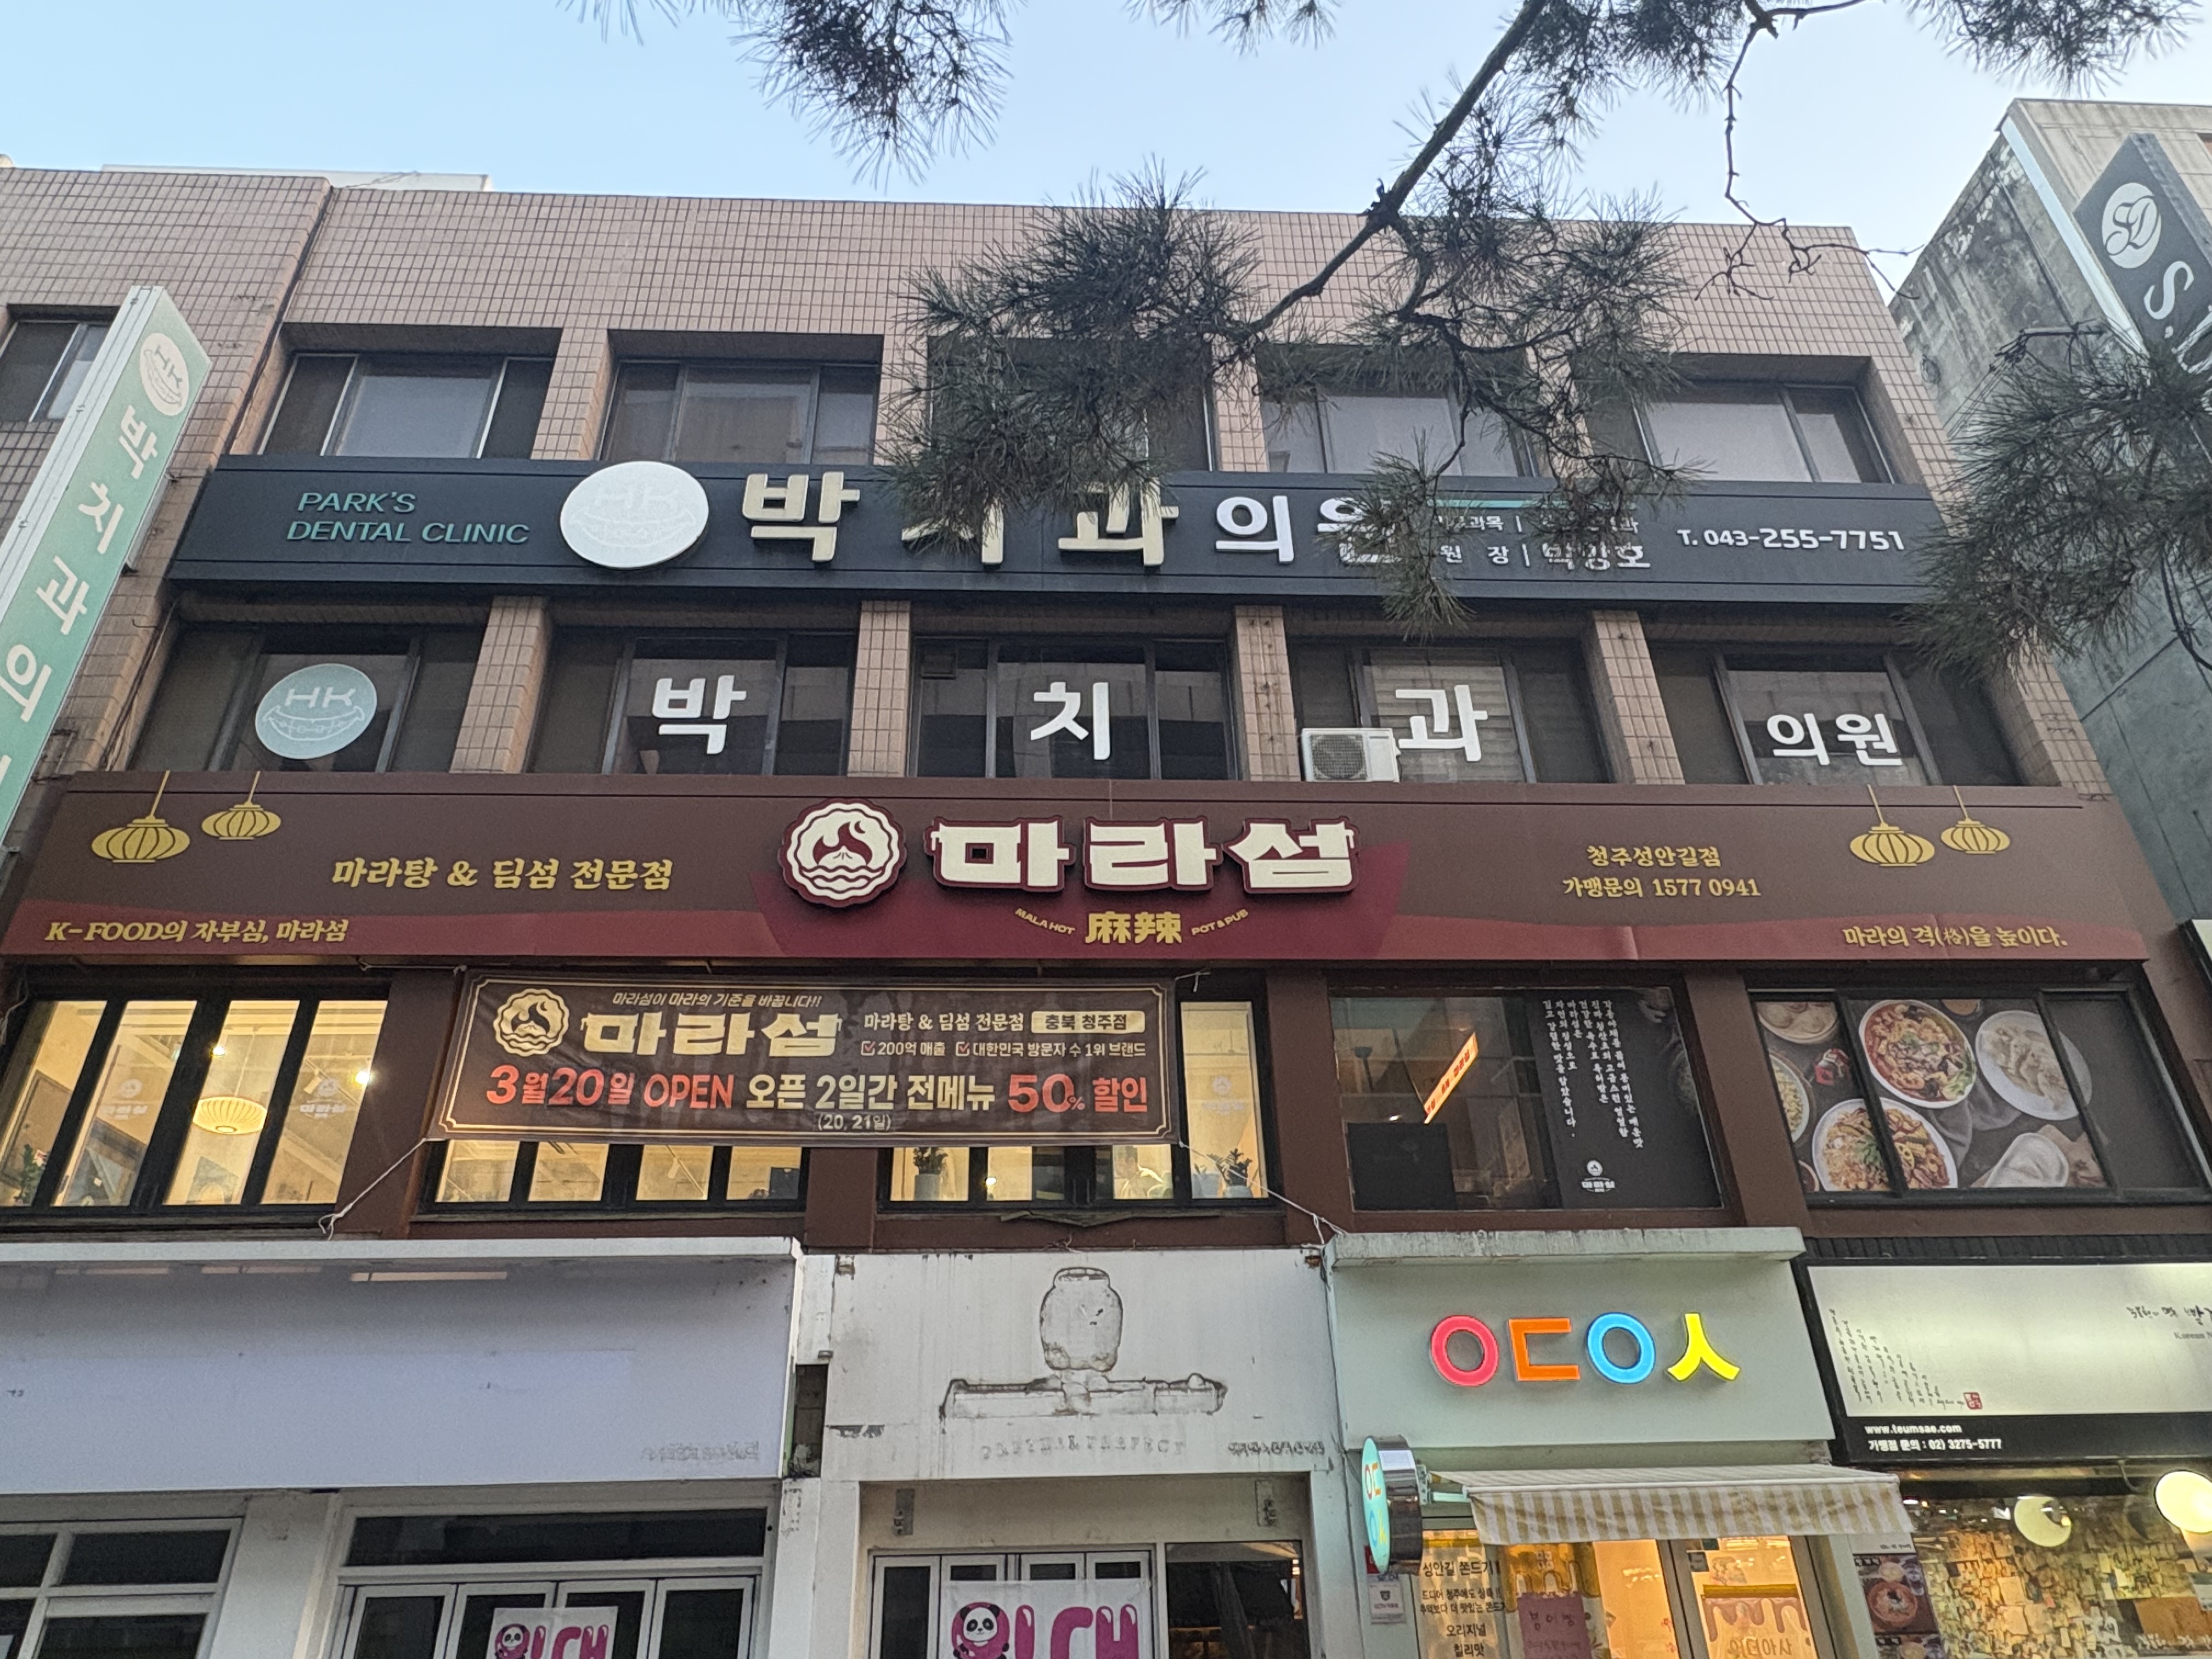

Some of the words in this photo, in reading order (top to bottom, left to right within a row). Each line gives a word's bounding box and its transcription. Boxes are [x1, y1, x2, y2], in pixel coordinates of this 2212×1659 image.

[297, 491, 416, 513] PARK'S
[286, 520, 413, 543] DENTAL
[421, 523, 531, 544] CLINIC
[1677, 529, 1698, 545] T.
[1703, 528, 1905, 550] 043-255-7751
[1440, 544, 1463, 564] 원
[1487, 545, 1510, 565] 장
[284, 685, 358, 709] HK
[651, 675, 747, 755] 박
[1030, 681, 1111, 761] 치
[1395, 685, 1488, 763] 과
[1767, 712, 1903, 766] 의원
[929, 819, 1356, 889] 마라섬
[1587, 845, 1722, 868] 청주성안길점
[331, 856, 438, 888] 마라탕
[447, 860, 478, 887] &
[492, 857, 560, 889] 딤섬
[570, 858, 674, 890] 전문점
[1562, 877, 1644, 898] 가맹문의
[1651, 878, 1702, 896] 1577
[1708, 878, 1762, 897] 0941
[44, 920, 187, 943] K-FOOD의
[190, 920, 269, 944] 자부심,
[275, 919, 349, 943] 마라섬
[1015, 907, 1048, 929] MALA
[1049, 921, 1076, 935] HOT
[1084, 911, 1183, 944] 麻辣
[1842, 925, 1910, 947] 마라의
[1995, 926, 2068, 948] 높이다.
[612, 992, 668, 1007] 마라섬이
[668, 992, 713, 1007] 마라의
[713, 993, 756, 1008] 기준을
[864, 1012, 914, 1032] 마라탕
[918, 1014, 933, 1030] &
[939, 1013, 970, 1032] 딤섬
[974, 1013, 1024, 1032] 전문점
[1045, 1014, 1076, 1030] 충북
[1081, 1013, 1128, 1030] 청주점
[581, 1012, 843, 1058] 마라섬
[878, 1042, 917, 1057] 200억
[919, 1042, 946, 1057] 매출
[972, 1042, 1024, 1057] 대한민국
[1027, 1042, 1066, 1058] 방문자
[1069, 1042, 1082, 1058] 수
[1085, 1042, 1105, 1058] 1위
[1108, 1042, 1147, 1058] 브랜드
[643, 1074, 735, 1109] OPEN
[746, 1074, 806, 1109] 오픈
[816, 1075, 897, 1110] 2일간
[906, 1075, 995, 1111] 전메뉴
[1007, 1073, 1085, 1113] 50%
[1092, 1077, 1148, 1113] 할인
[1948, 1438, 2002, 1450] 3275-5777
[1422, 1560, 1455, 1578] 성안길
[1446, 1623, 1487, 1637] 오리지널
[1454, 1643, 1485, 1658] 칠리맛
